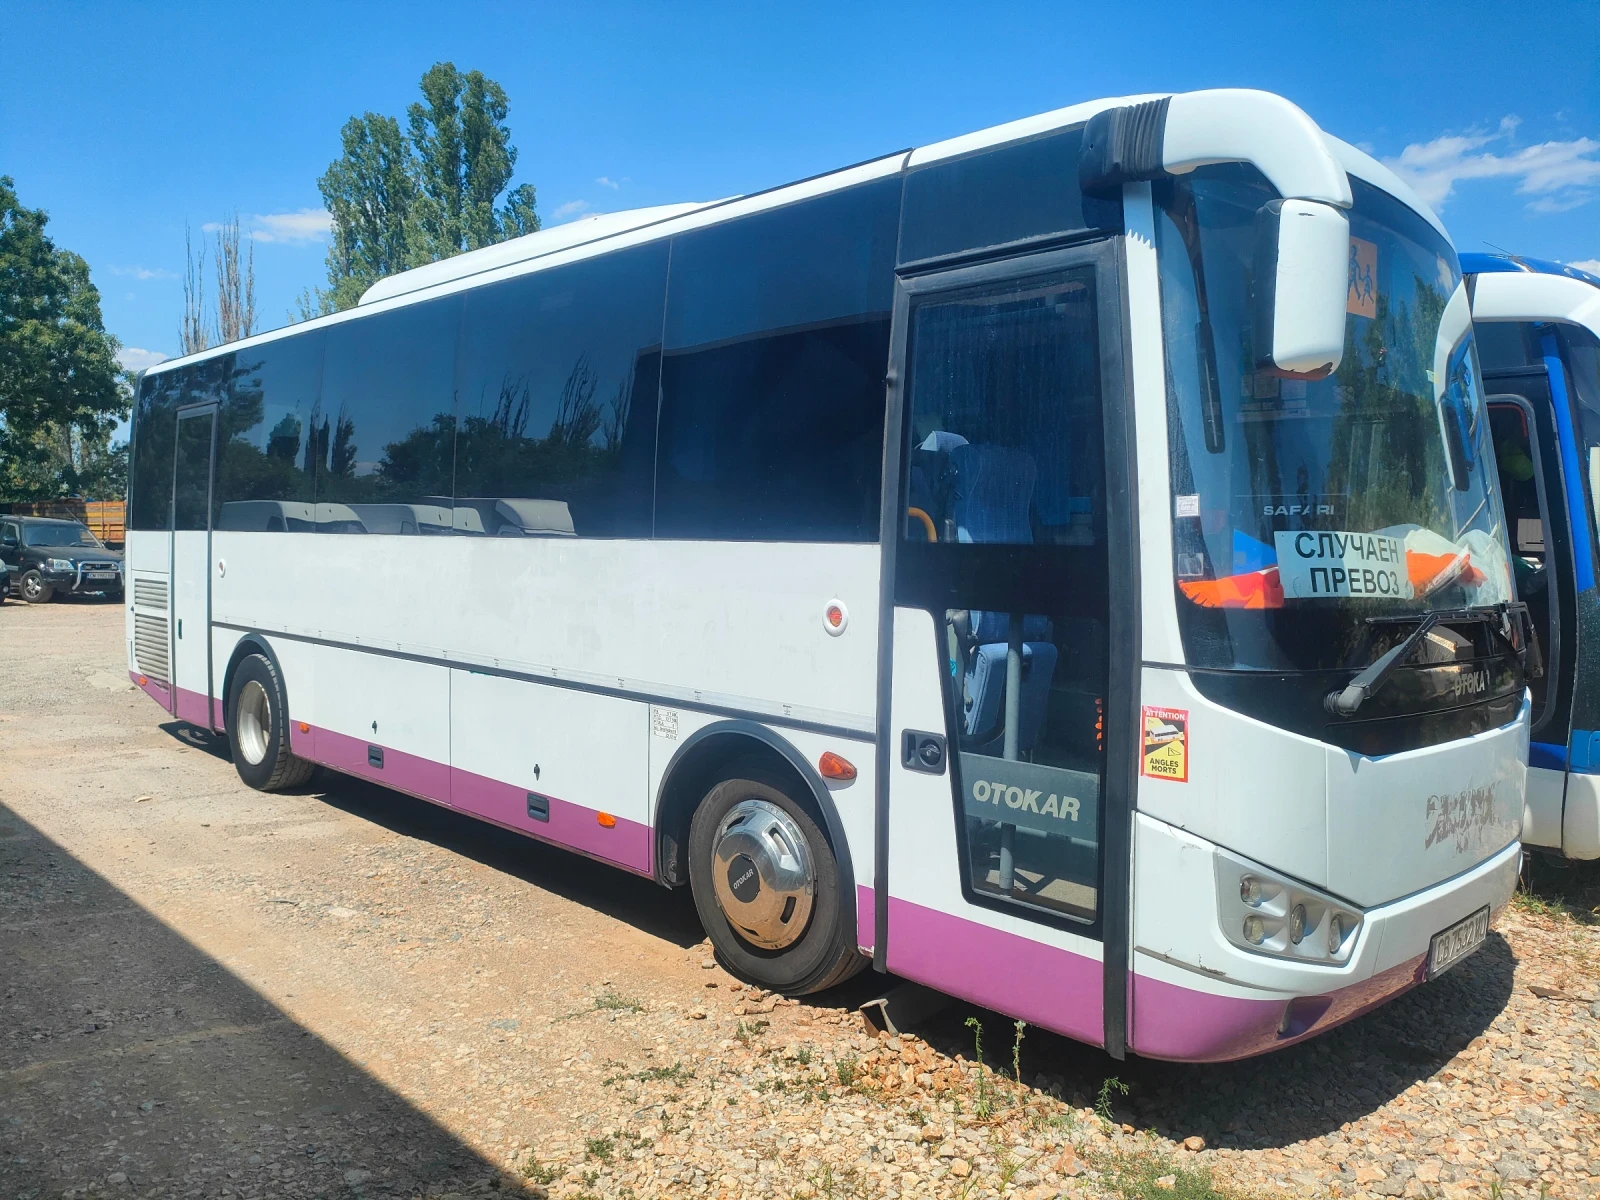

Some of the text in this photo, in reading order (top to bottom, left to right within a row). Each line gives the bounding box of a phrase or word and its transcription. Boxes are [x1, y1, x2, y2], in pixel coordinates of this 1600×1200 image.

[1294, 532, 1400, 564] СЛУЧАЕН
[1309, 567, 1400, 596] ПРЕВОЗ
[1146, 711, 1185, 720] ATTENTION
[1150, 758, 1179, 768] ANGLES
[1151, 765, 1177, 774] MORTS
[972, 780, 1081, 821] OTOKAR
[733, 868, 754, 890] OTOKAR
